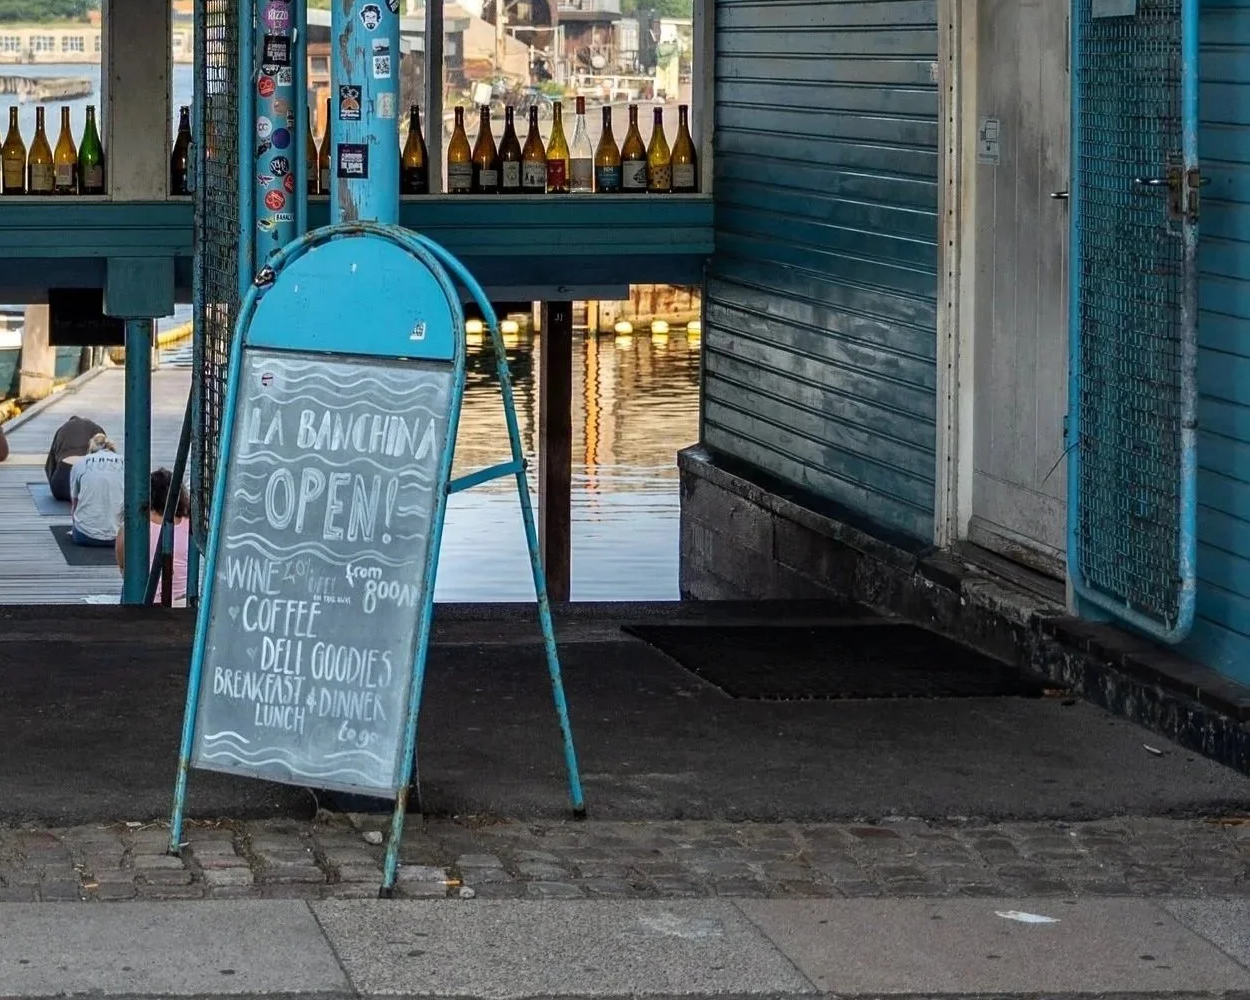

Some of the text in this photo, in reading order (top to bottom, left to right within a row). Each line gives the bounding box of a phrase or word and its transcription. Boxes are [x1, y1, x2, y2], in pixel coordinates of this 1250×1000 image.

[249, 406, 438, 461] LA BANCHINA
[264, 466, 400, 545] OPEN!
[226, 554, 281, 595] WINE
[346, 563, 383, 588] from
[242, 594, 322, 638] COFFEE
[261, 635, 393, 688] DELI GOODIES
[213, 666, 306, 705] BREAKFAST
[318, 687, 387, 722] DINNER
[254, 702, 306, 735] LUNCH
